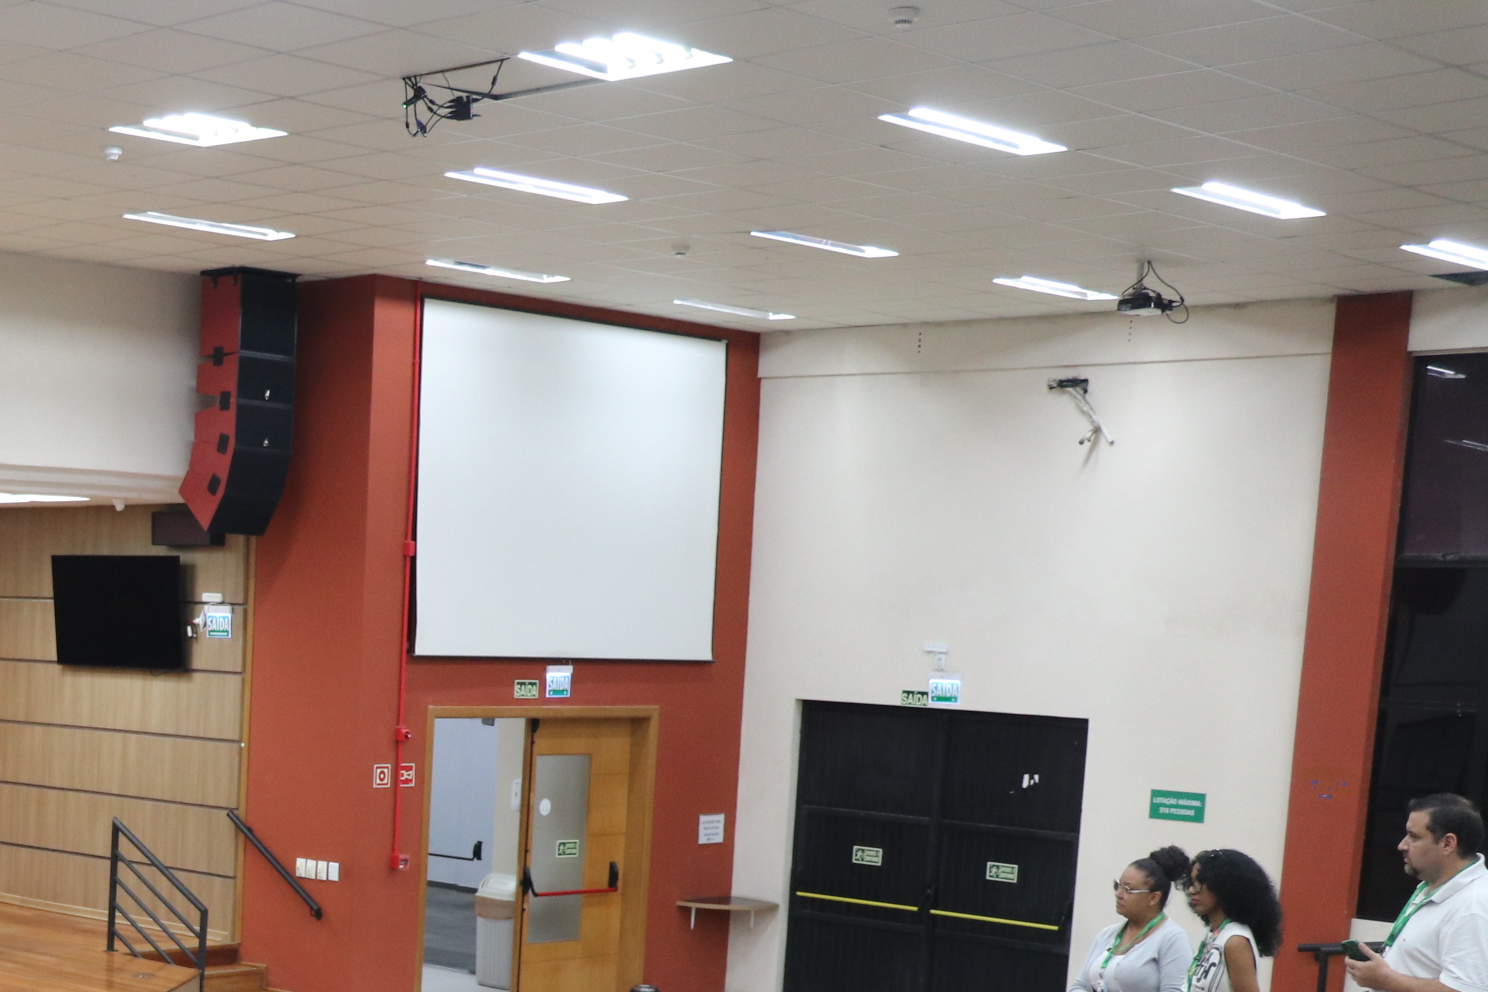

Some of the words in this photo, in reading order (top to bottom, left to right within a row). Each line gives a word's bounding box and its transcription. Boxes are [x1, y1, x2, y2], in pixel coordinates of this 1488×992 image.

[207, 615, 230, 631] SAÍDA
[515, 682, 538, 697] SAÍDA
[901, 690, 928, 706] SAÍDA
